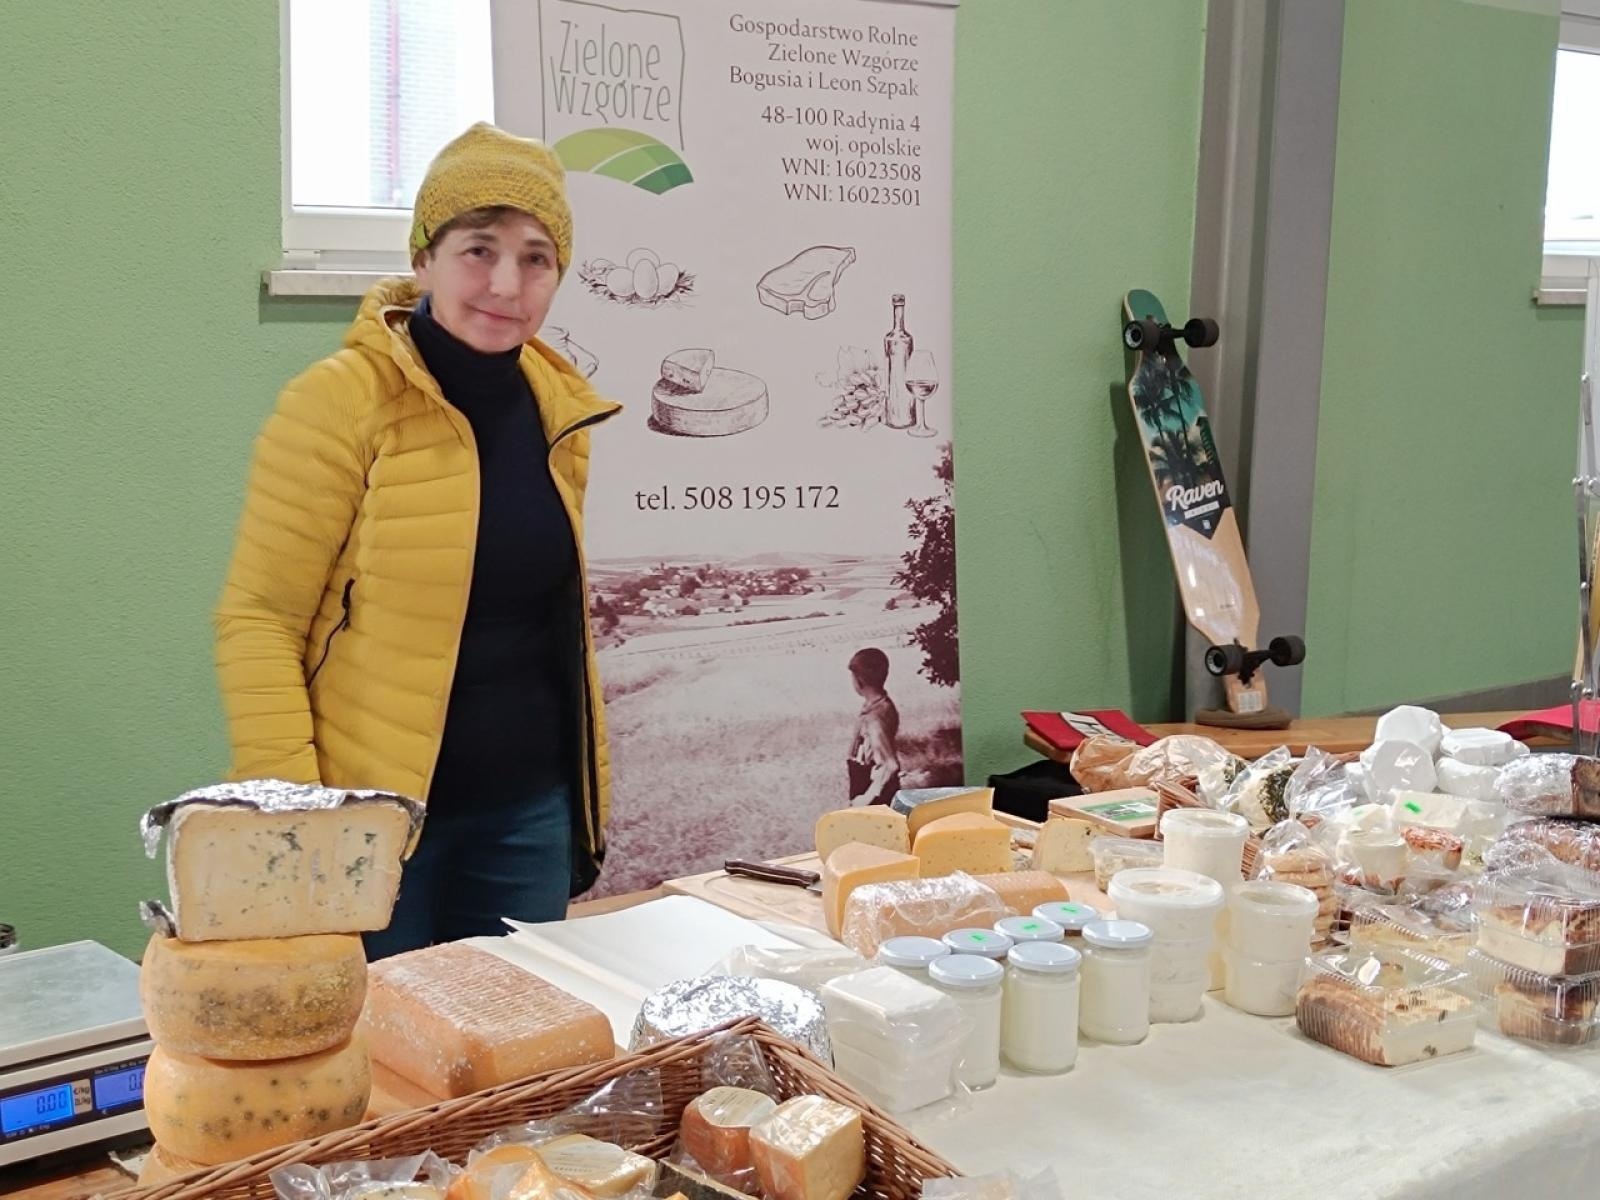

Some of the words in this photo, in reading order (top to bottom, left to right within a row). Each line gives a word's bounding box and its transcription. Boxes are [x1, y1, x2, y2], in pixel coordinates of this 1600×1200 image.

[729, 13, 864, 42] Gospodarstwo
[868, 25, 919, 47] Rolne
[560, 20, 660, 81] Zielone
[768, 43, 837, 65] Zielone
[842, 49, 919, 74] Wzgórze
[550, 56, 671, 124] Wzgórze
[730, 65, 802, 91] Bogusia
[808, 70, 813, 88] i
[819, 72, 862, 92] Leon
[867, 75, 919, 100] Szpak
[761, 106, 827, 126] 48-100
[833, 109, 906, 134] Radynia
[910, 115, 921, 132] 4
[806, 135, 844, 155] woj.
[848, 137, 921, 158] opolskie
[782, 157, 830, 177] WNI:
[836, 159, 921, 182] 16023508
[784, 183, 832, 202] WNI:
[839, 185, 920, 206] 16023501
[635, 485, 676, 510] tel.
[683, 486, 733, 510] 508
[742, 486, 786, 509] 195
[796, 485, 840, 509] 172
[1165, 480, 1224, 511] Raven
[36, 1090, 67, 1115] 0.00
